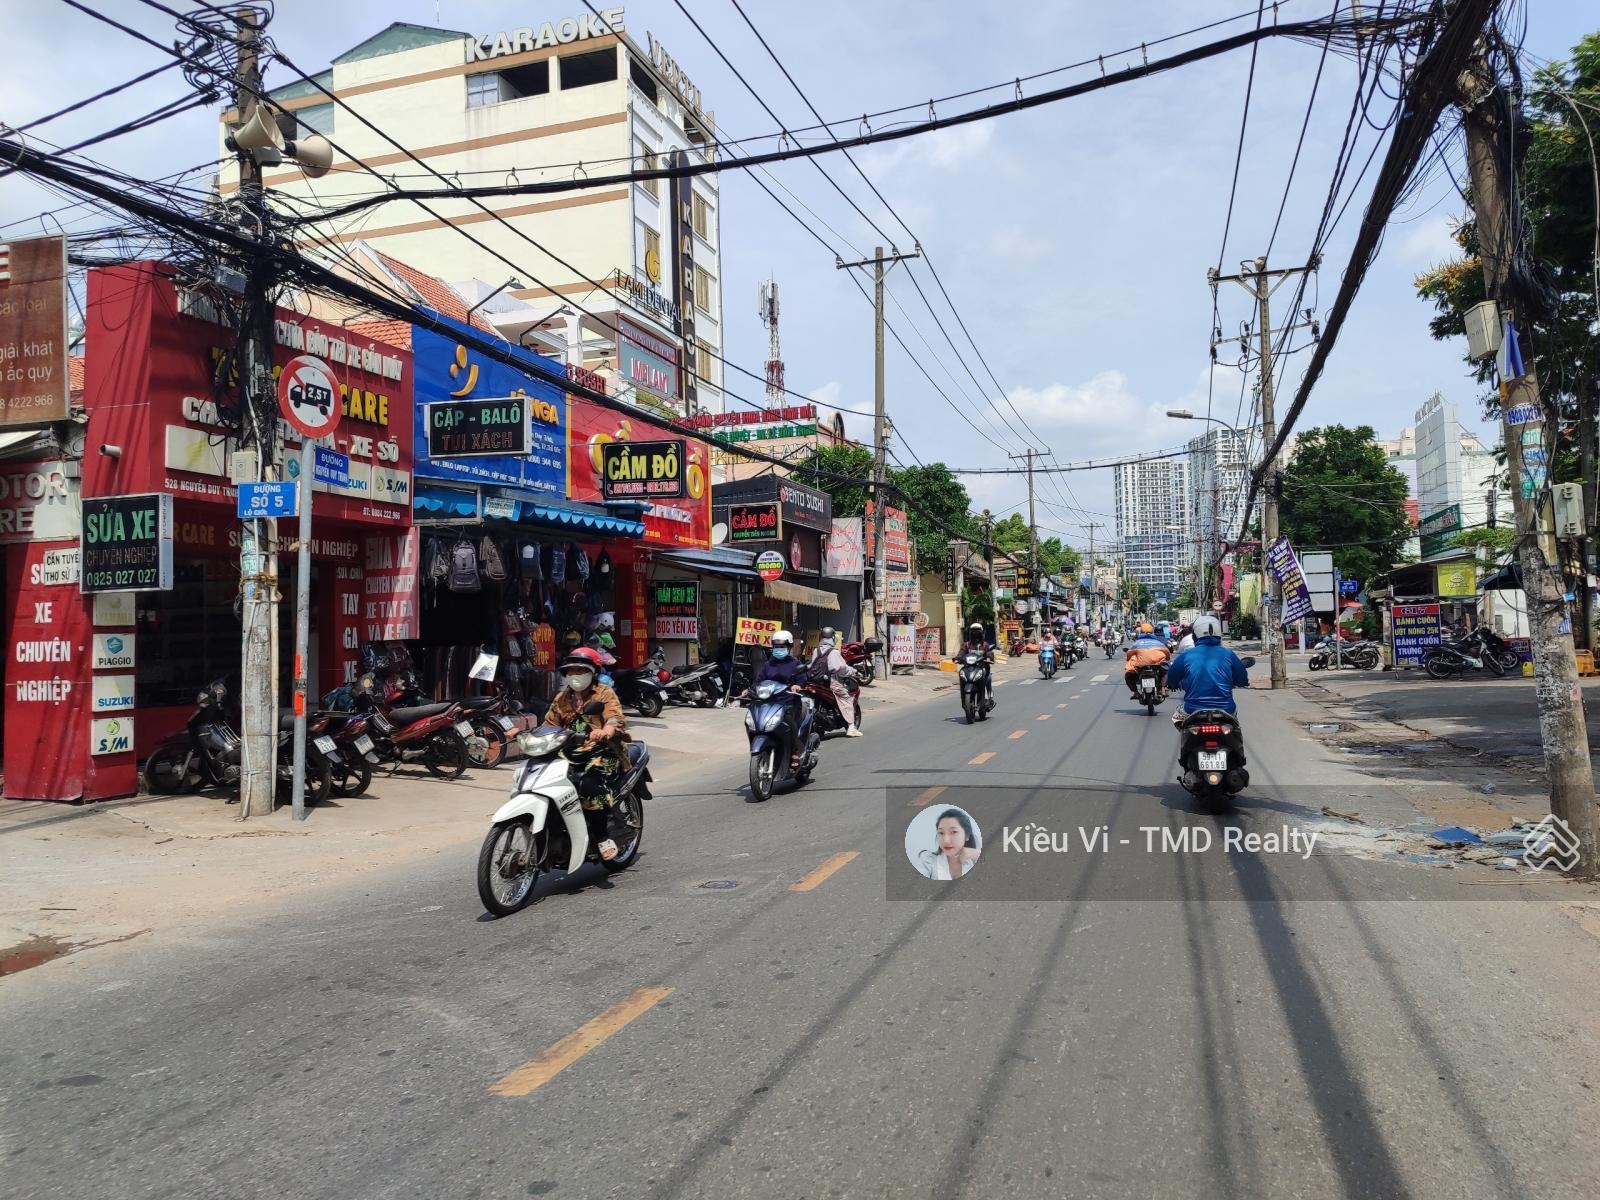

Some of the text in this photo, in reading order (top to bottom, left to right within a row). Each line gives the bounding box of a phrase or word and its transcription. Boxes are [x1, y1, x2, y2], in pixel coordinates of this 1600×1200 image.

[465, 6, 625, 63] KARAOKE
[682, 203, 698, 415] KARAOKE
[28, 365, 52, 382] quy
[8, 397, 32, 409] 4222
[35, 394, 54, 407] 966
[308, 386, 328, 400] 2,5T
[434, 408, 464, 430] CẶP
[481, 402, 521, 424] BALÔ
[351, 434, 373, 458] XE
[608, 443, 678, 480] CẦM ĐỒ
[164, 478, 178, 489] 528
[254, 484, 281, 494] ĐƯỜNG
[348, 478, 367, 490] ZUKI
[251, 494, 284, 508] SỐ 5
[806, 493, 824, 512] SUSHI
[87, 504, 126, 544] SỬA
[132, 510, 156, 540] XE
[398, 534, 413, 568] XE
[86, 568, 156, 586] 0825 027 027
[34, 602, 52, 624] XE
[342, 594, 358, 616] TAY
[366, 602, 376, 620] XE
[380, 601, 398, 618] TAY
[656, 618, 696, 636] BỌC YÊN XE
[741, 620, 776, 632] BỌC
[344, 627, 358, 649] GA
[738, 632, 772, 645] YÊN X
[16, 636, 70, 662] CHUYÊN
[98, 656, 132, 666] PIAGGIO
[344, 660, 358, 682] XE
[16, 676, 72, 706] NGHIỆP
[98, 696, 134, 707] SUZUKI
